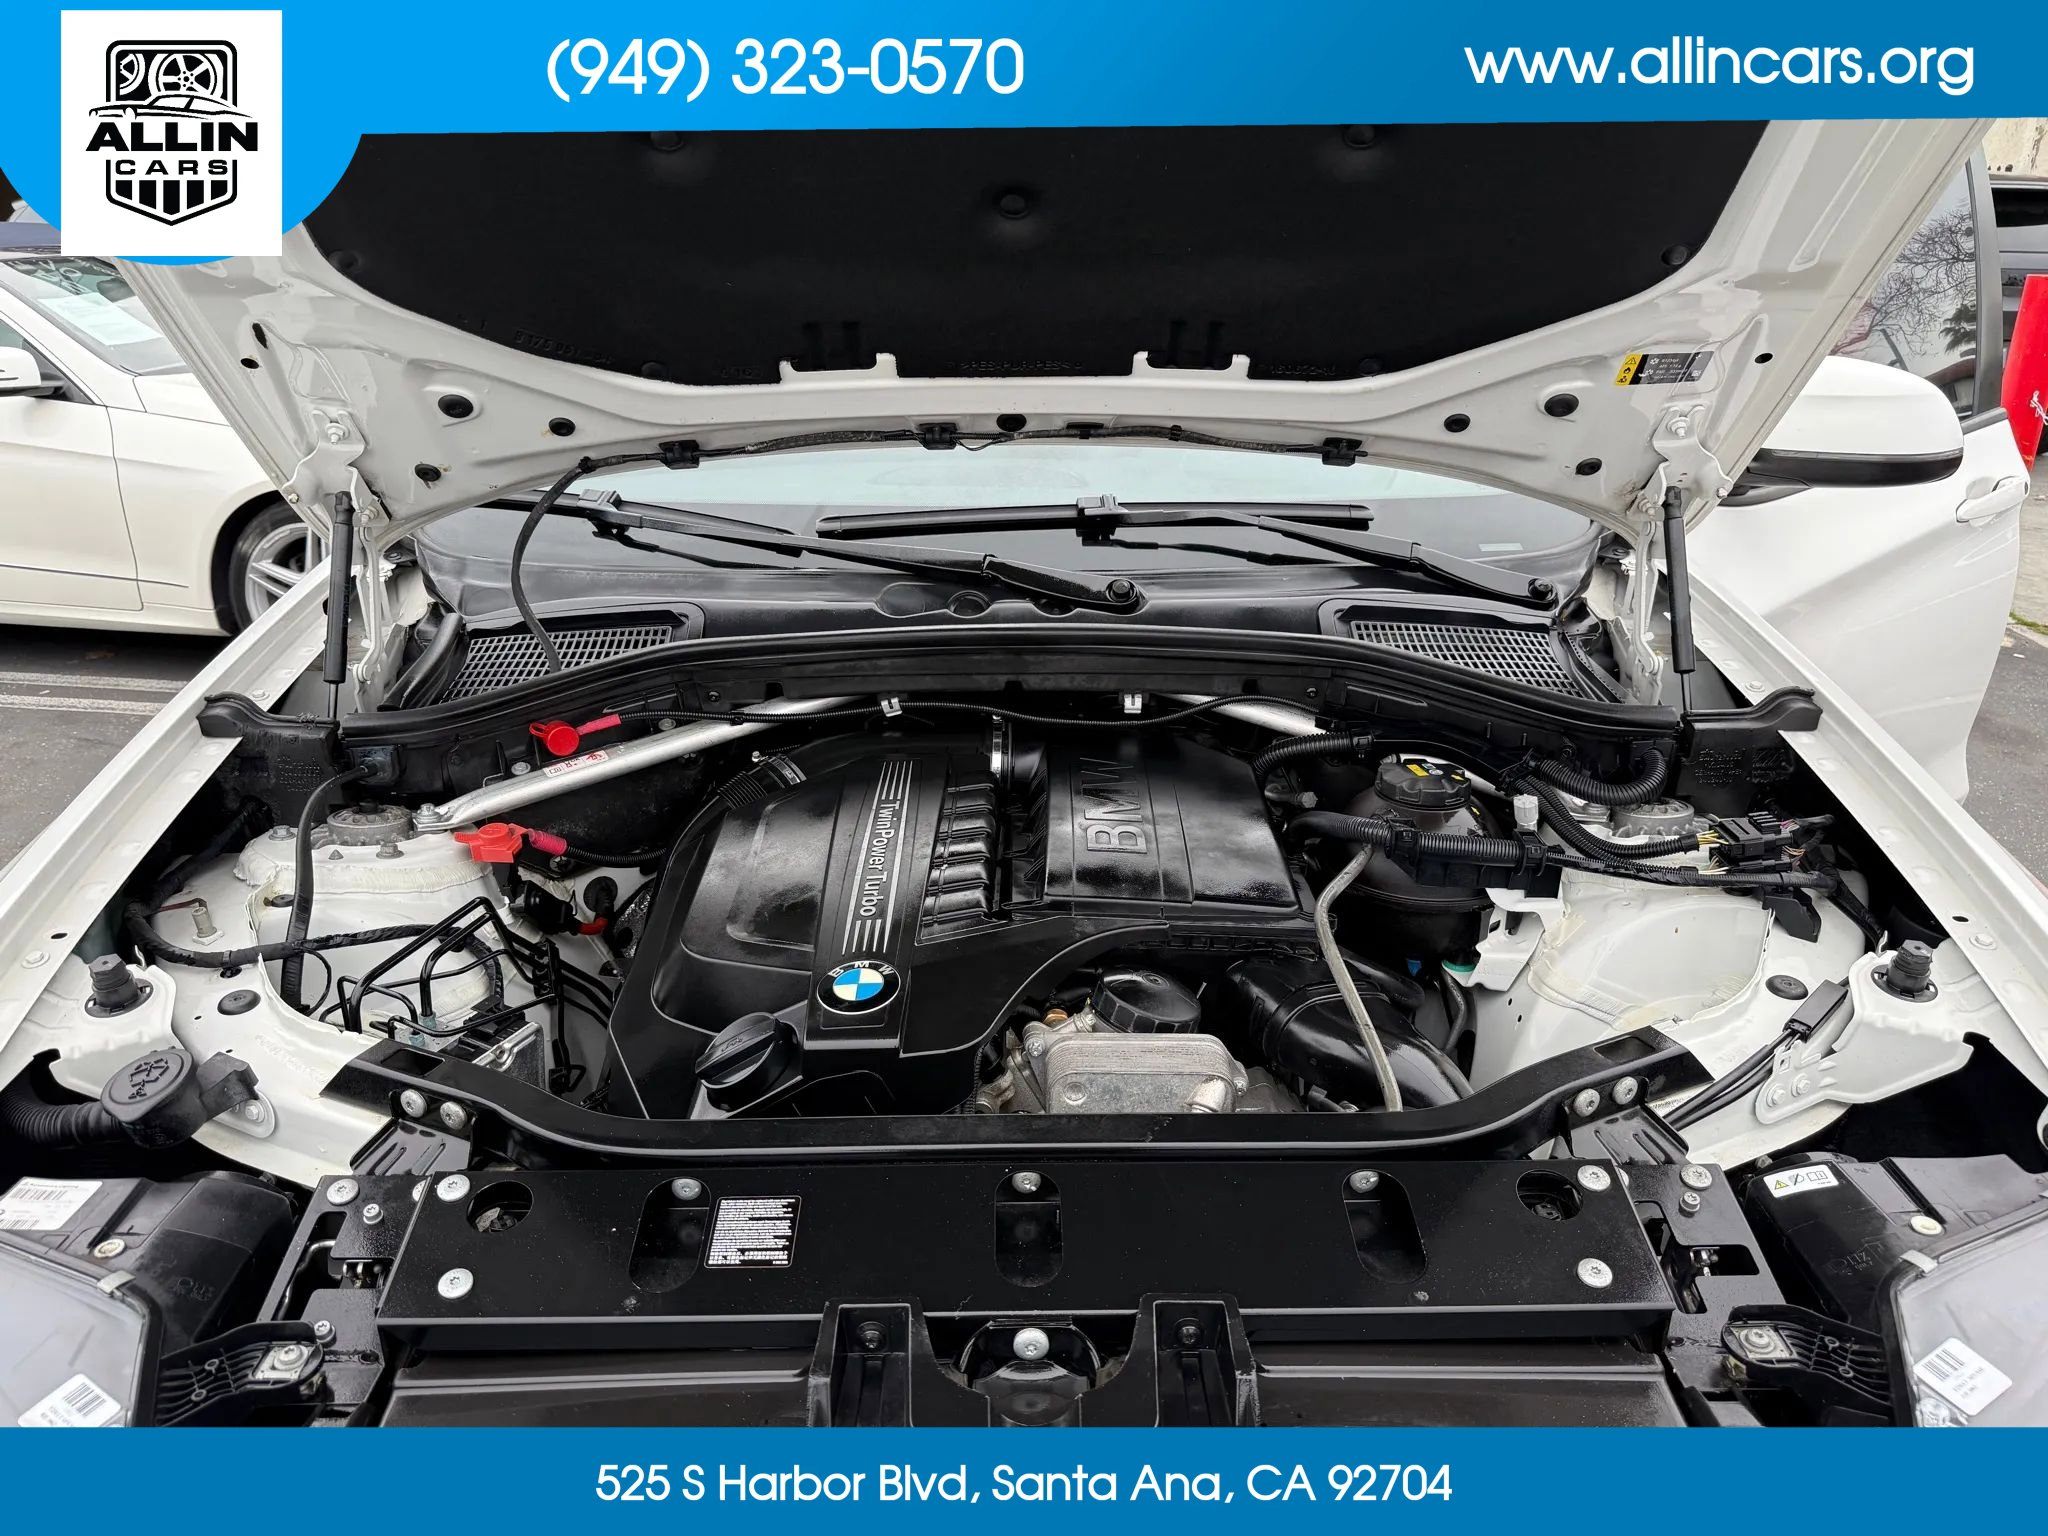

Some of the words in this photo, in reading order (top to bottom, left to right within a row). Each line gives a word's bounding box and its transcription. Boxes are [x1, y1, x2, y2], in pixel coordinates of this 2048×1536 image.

[1079, 757, 1147, 855] BMW
[859, 875, 887, 917] Turbo
[828, 960, 896, 978] BMW
